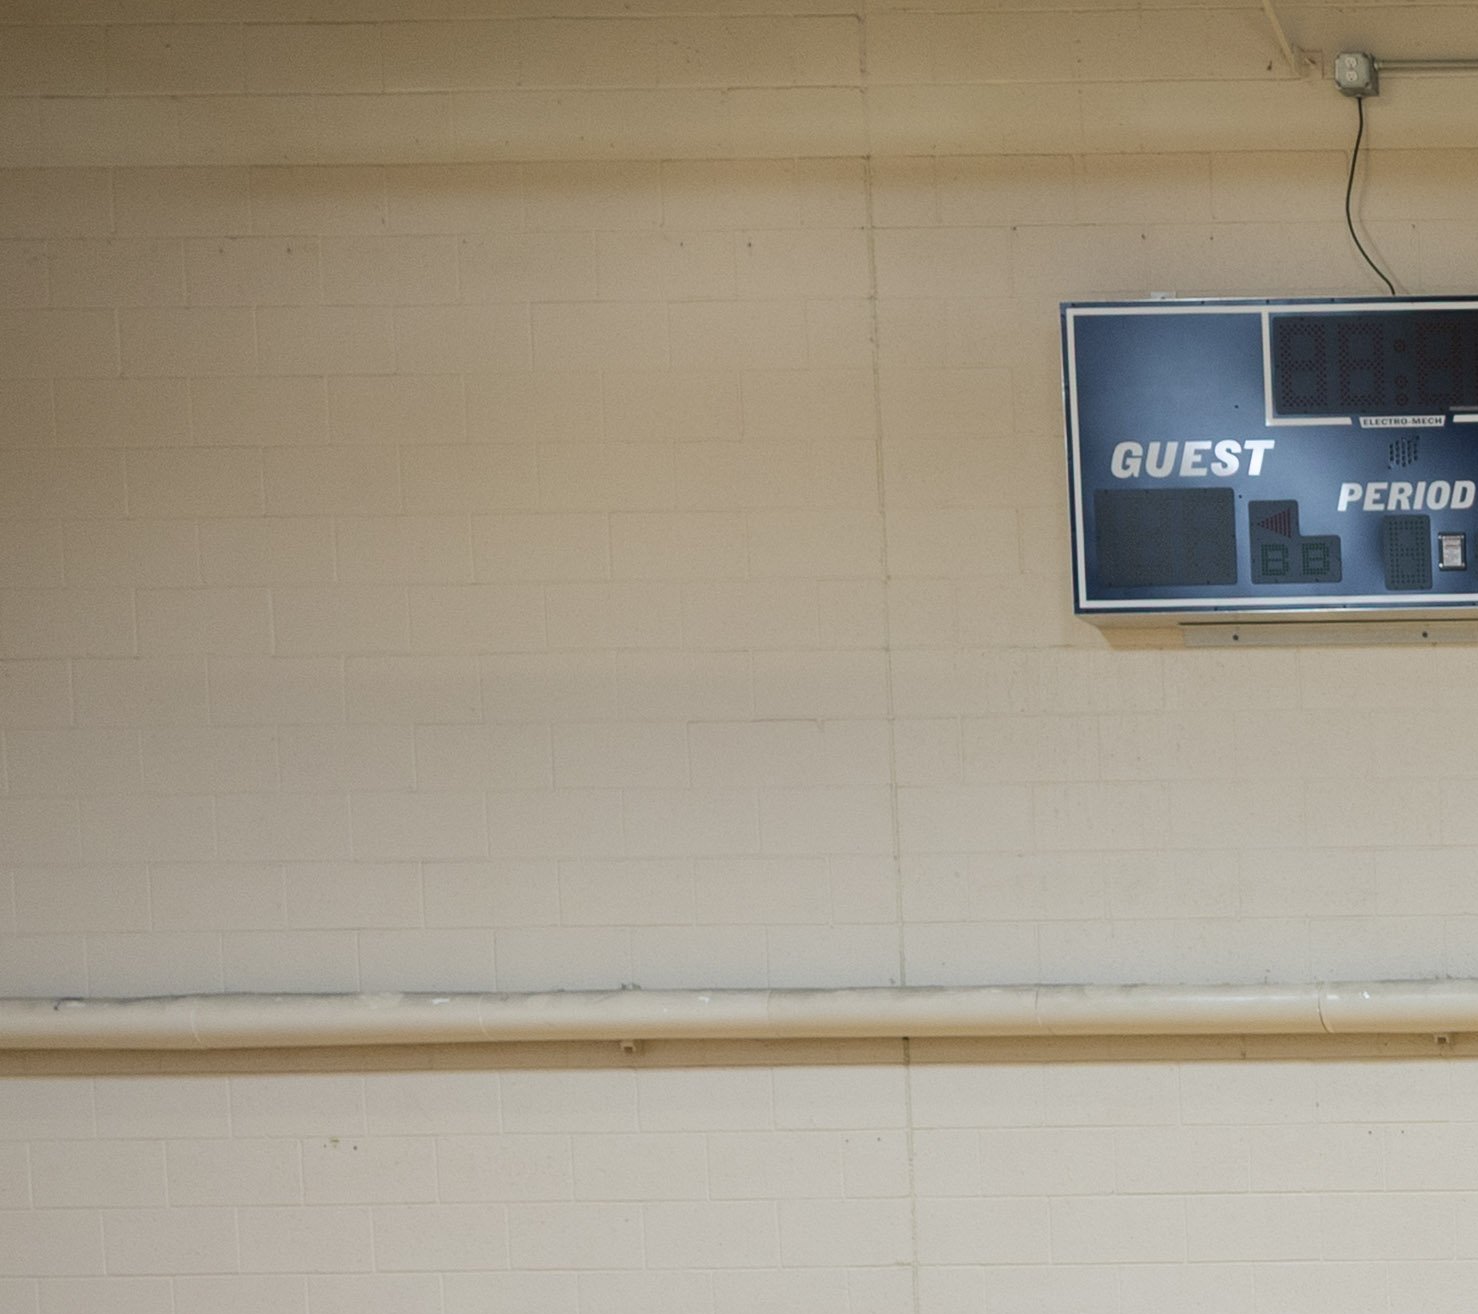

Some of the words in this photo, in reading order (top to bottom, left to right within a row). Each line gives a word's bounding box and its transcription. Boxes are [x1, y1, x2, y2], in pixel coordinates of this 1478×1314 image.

[1363, 417, 1442, 426] ELECTRO-MECH
[1110, 439, 1275, 479] GUEST
[1337, 480, 1476, 512] PERIOD
